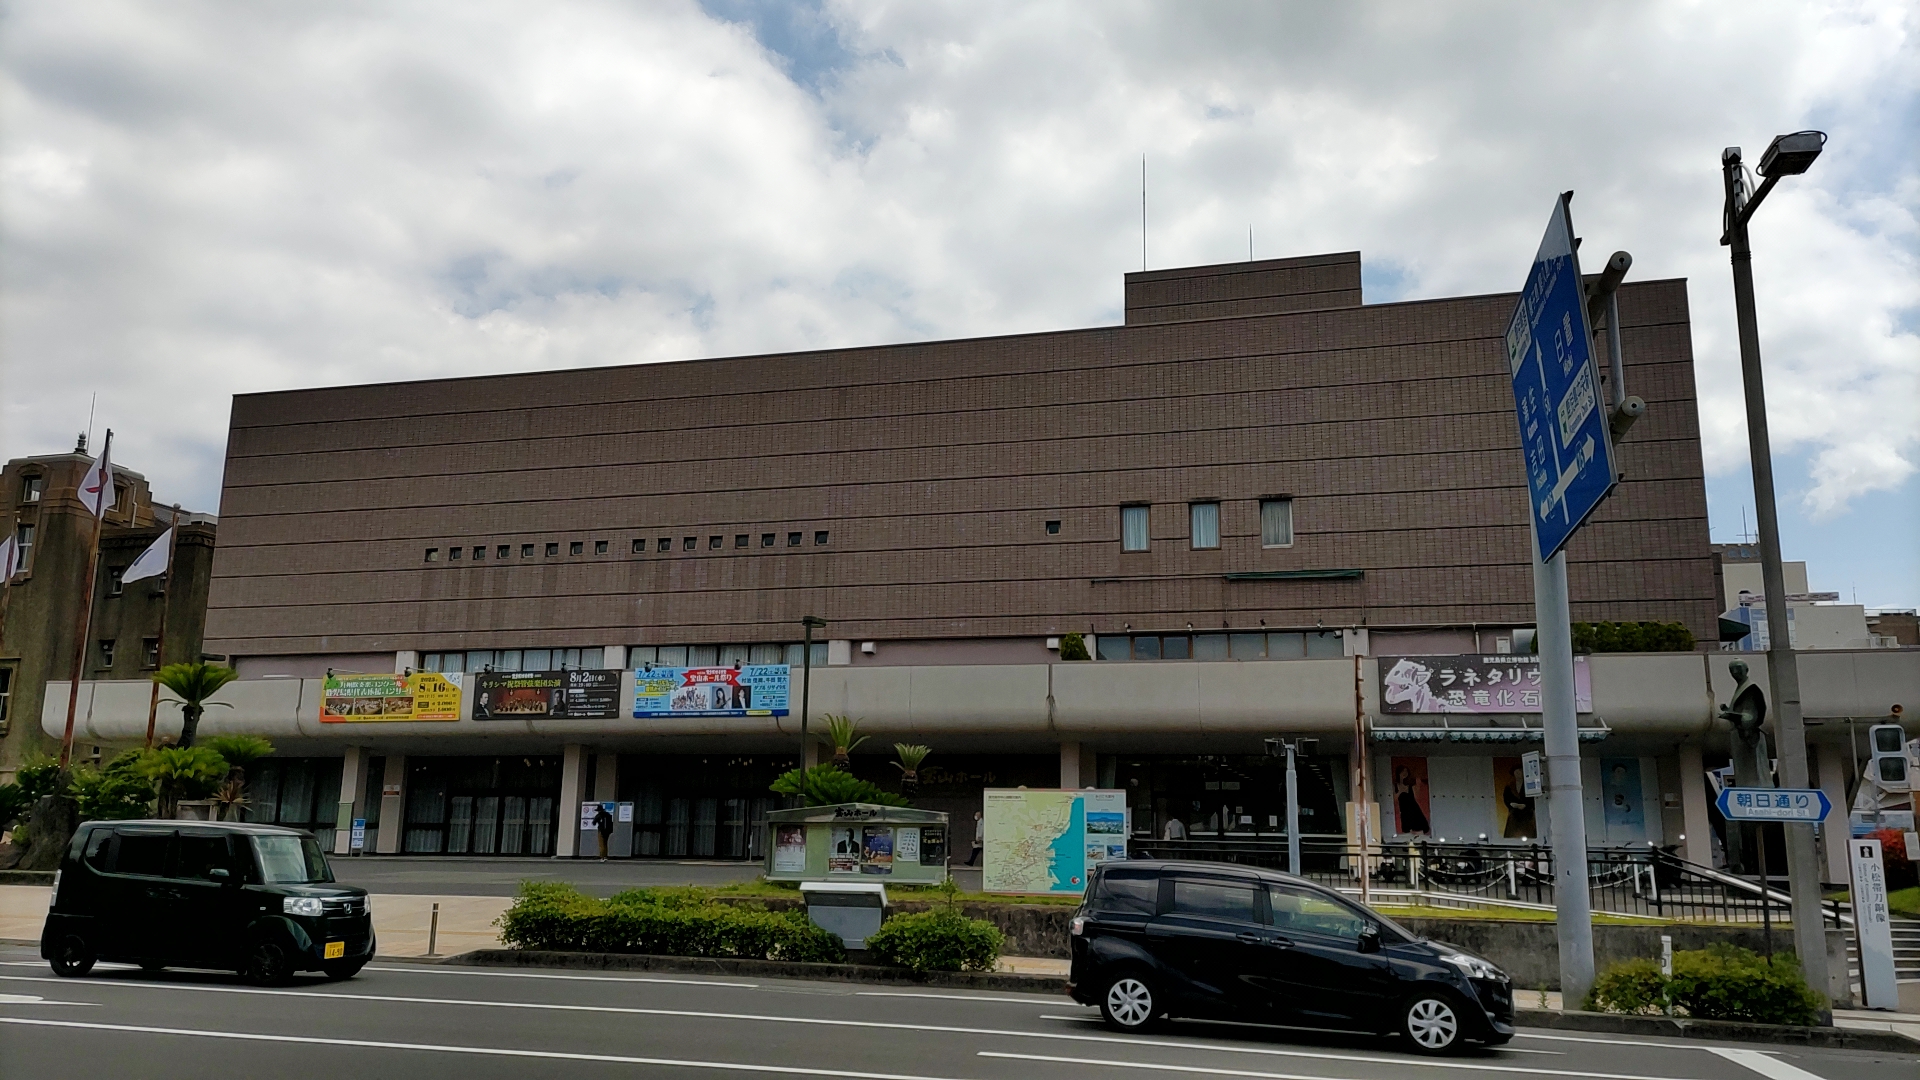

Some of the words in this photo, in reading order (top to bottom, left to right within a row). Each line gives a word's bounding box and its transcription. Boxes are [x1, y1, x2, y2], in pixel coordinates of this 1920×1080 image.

[690, 674, 732, 682] 宝山ホール祭り
[1448, 690, 1540, 706] 恐竜化石
[1736, 793, 1809, 808] 朝日通り
[834, 807, 877, 818] 宝山ホール
[1871, 863, 1885, 923] 小松帯刀銅像
